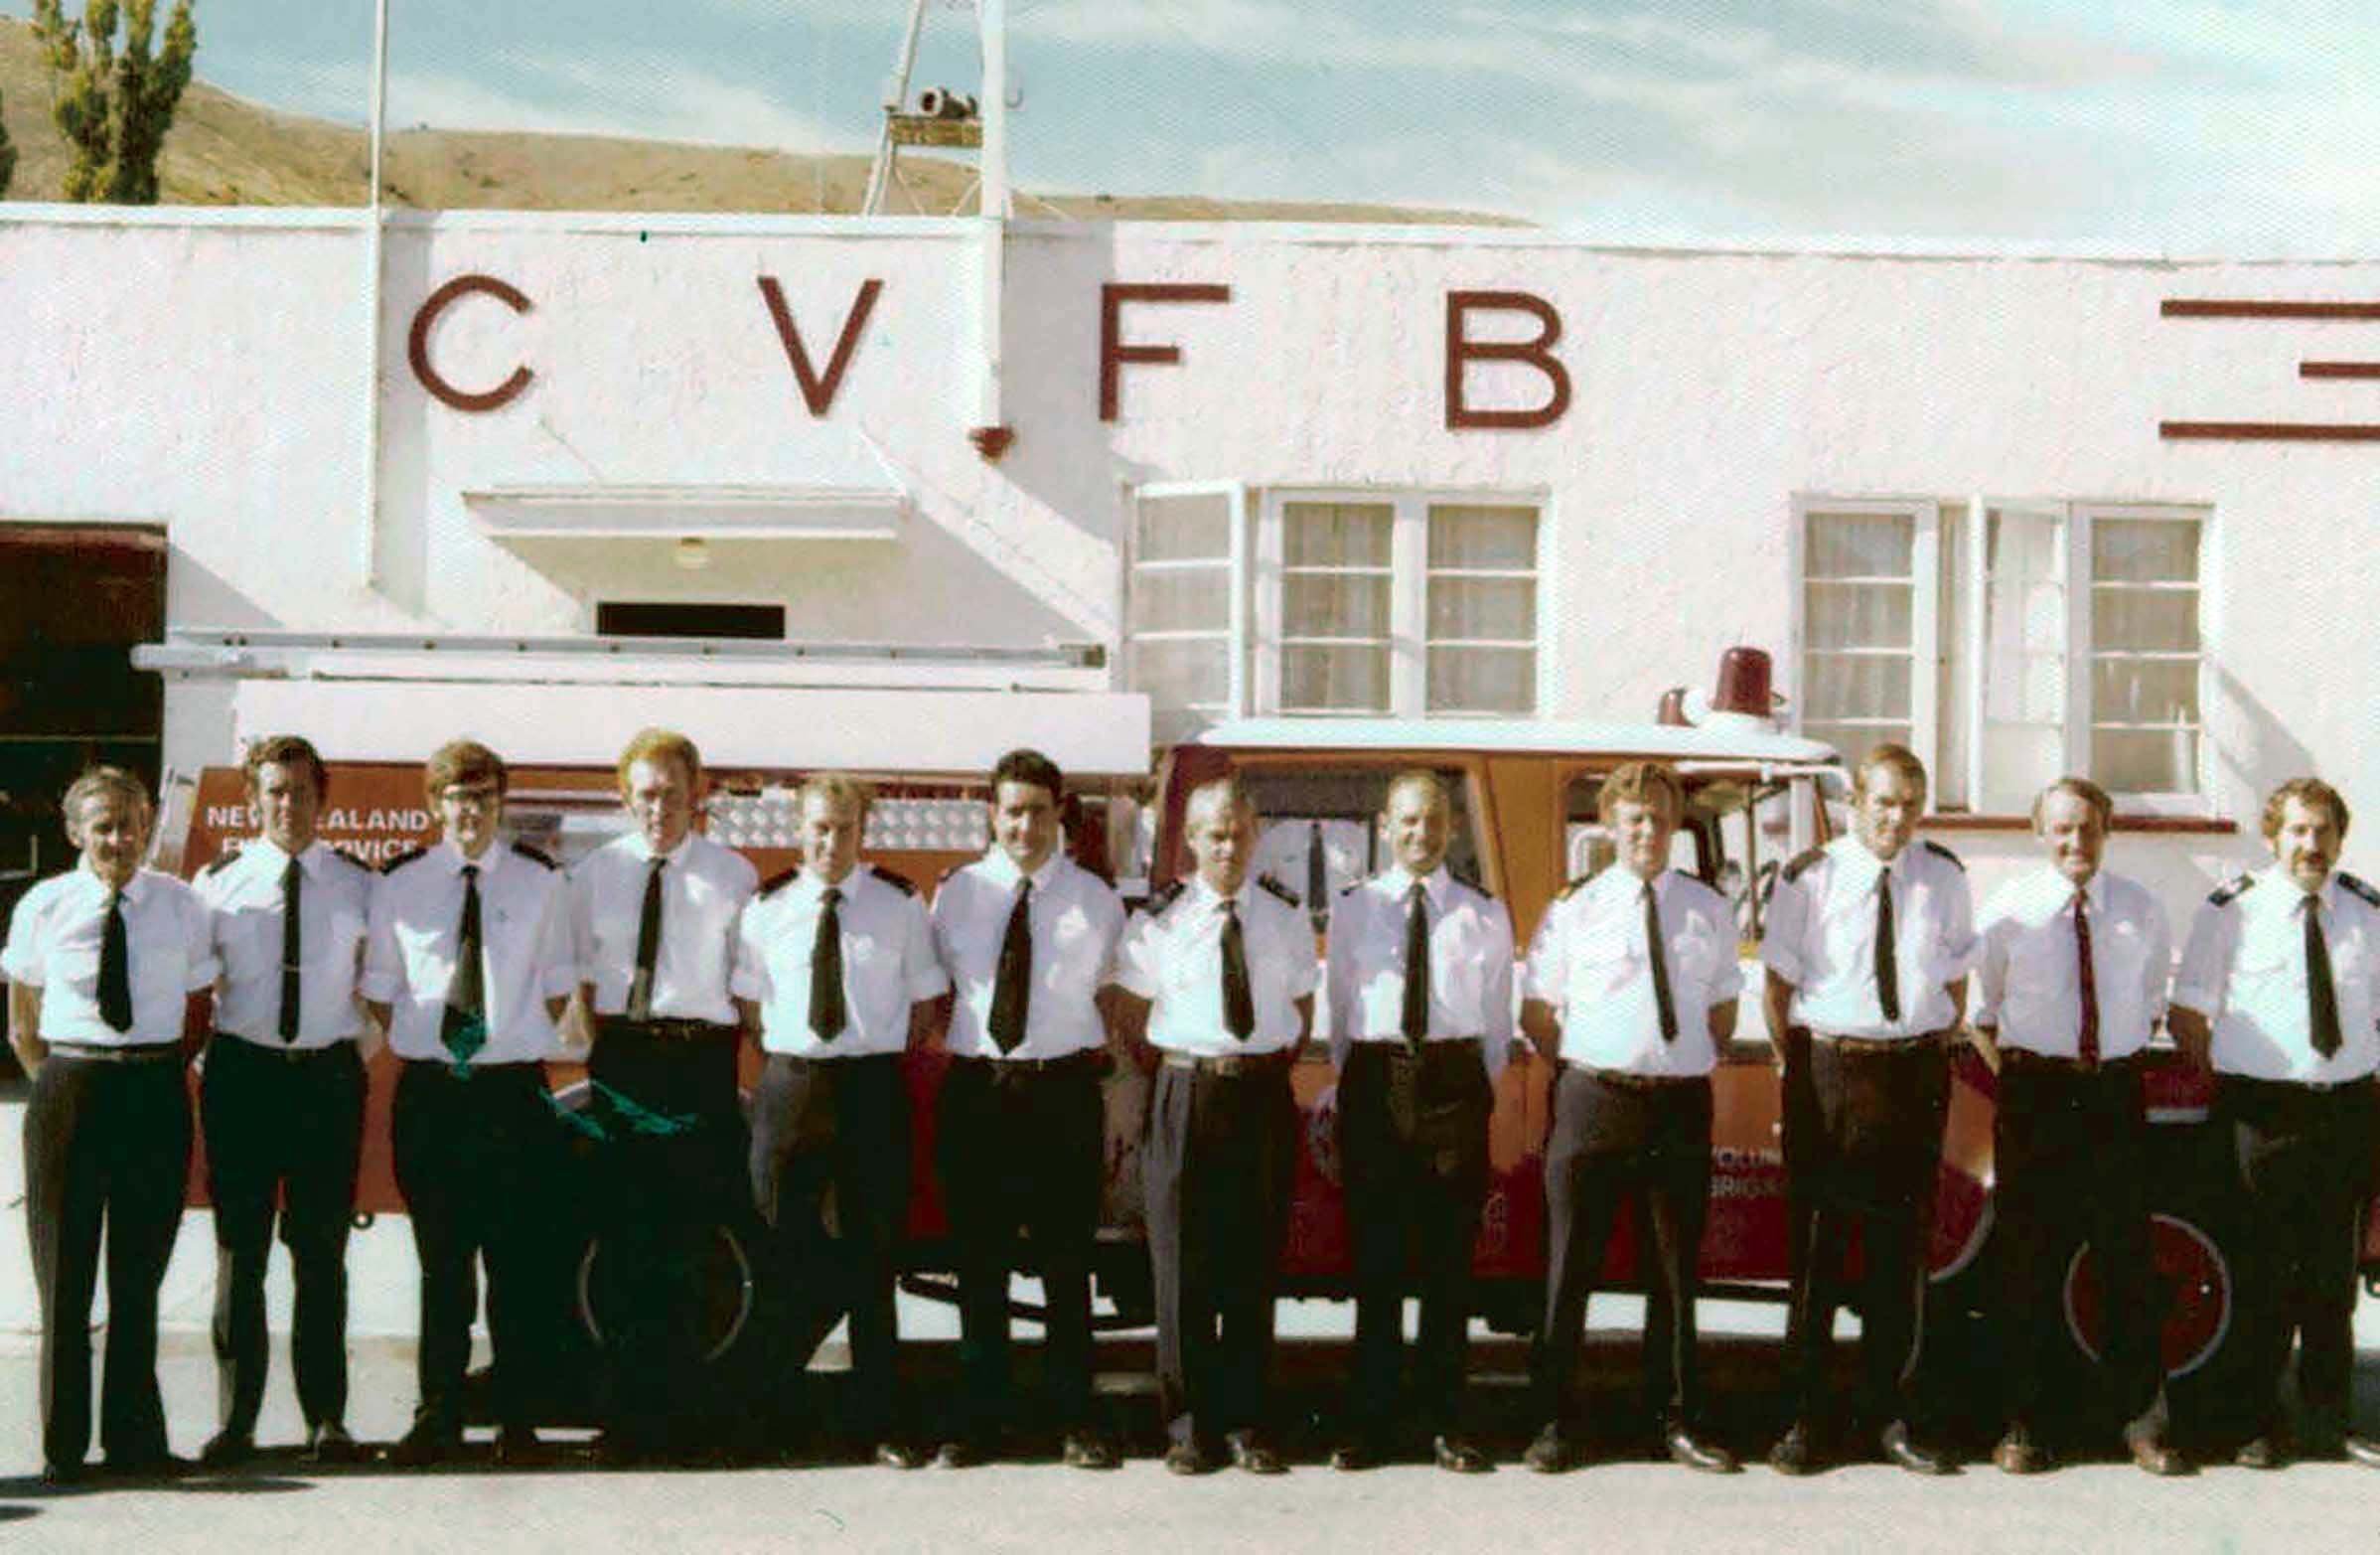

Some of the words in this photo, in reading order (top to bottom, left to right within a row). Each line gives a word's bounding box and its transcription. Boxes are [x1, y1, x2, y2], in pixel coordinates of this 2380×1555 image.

[406, 274, 534, 414] C
[757, 275, 884, 417] V
[1098, 282, 1231, 424] F
[1444, 290, 1572, 431] B
